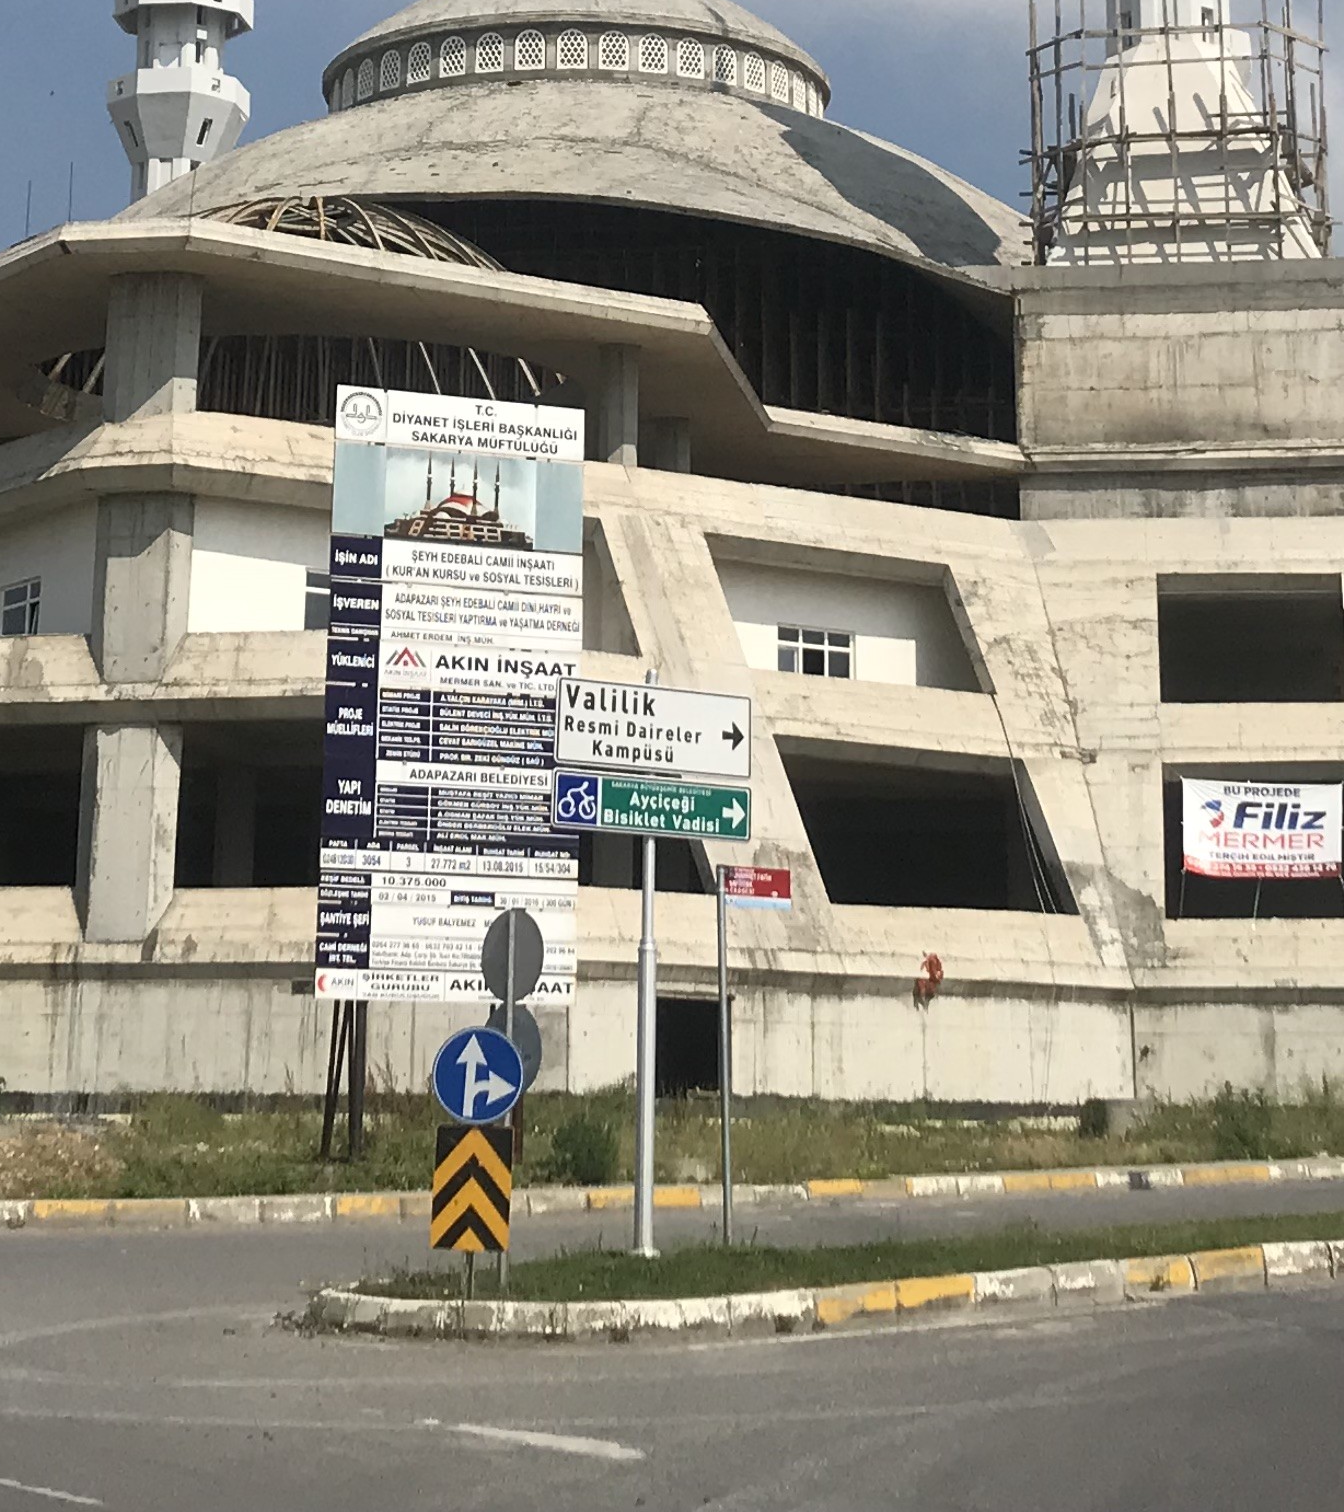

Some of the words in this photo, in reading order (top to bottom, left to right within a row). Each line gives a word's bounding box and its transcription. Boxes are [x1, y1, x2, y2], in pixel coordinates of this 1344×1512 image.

[475, 405, 497, 416] T.C.
[393, 412, 449, 428] DİYANET
[453, 418, 495, 434] İŞLERİ
[499, 423, 577, 441] BAŞKANLIĞI
[411, 431, 473, 447] SAKARYA
[478, 437, 558, 455] MÜFTÜLÜĞÜ
[334, 549, 357, 565] İŞİN
[358, 551, 378, 565] ADI
[412, 550, 438, 563] ŞEYH
[441, 552, 483, 565] EDEBALİ
[433, 568, 466, 581] KURSU
[469, 573, 480, 582] ve
[483, 572, 521, 584] SOSYAL
[524, 573, 573, 588] TESİSLERİ
[333, 592, 380, 611] İŞVEREN
[395, 593, 438, 605] ADAPAZARI
[441, 595, 461, 609] ŞEYH
[385, 608, 415, 621] SOSYAL
[510, 617, 544, 631] YAŞATMA
[391, 631, 420, 639] AHMET
[423, 633, 452, 641] ERDEM
[331, 651, 375, 668] YÜKLENİCİ
[435, 654, 489, 672] AKIN
[497, 655, 576, 679] İNŞAAT
[440, 676, 480, 687] MERMER
[566, 684, 656, 717] Valilik
[338, 707, 363, 720] PROJE
[564, 715, 619, 737] Resmi
[626, 721, 702, 744] Daireler
[592, 740, 674, 763] Kampüsü
[409, 768, 477, 782] ADAPAZARI
[480, 770, 548, 786] BELEDİYESİ
[337, 779, 362, 795] YAPI
[1224, 785, 1240, 795] BU
[1243, 786, 1301, 797] PROJEDE
[325, 797, 372, 815] DENETİM
[629, 791, 695, 814] Ayçiçeği
[603, 809, 665, 828] Bisiklet
[672, 815, 720, 833] Vadisi
[1233, 801, 1327, 830] Filiz
[1198, 830, 1324, 849] MERMER
[406, 856, 411, 867] 3
[382, 876, 446, 887] 10.375.000
